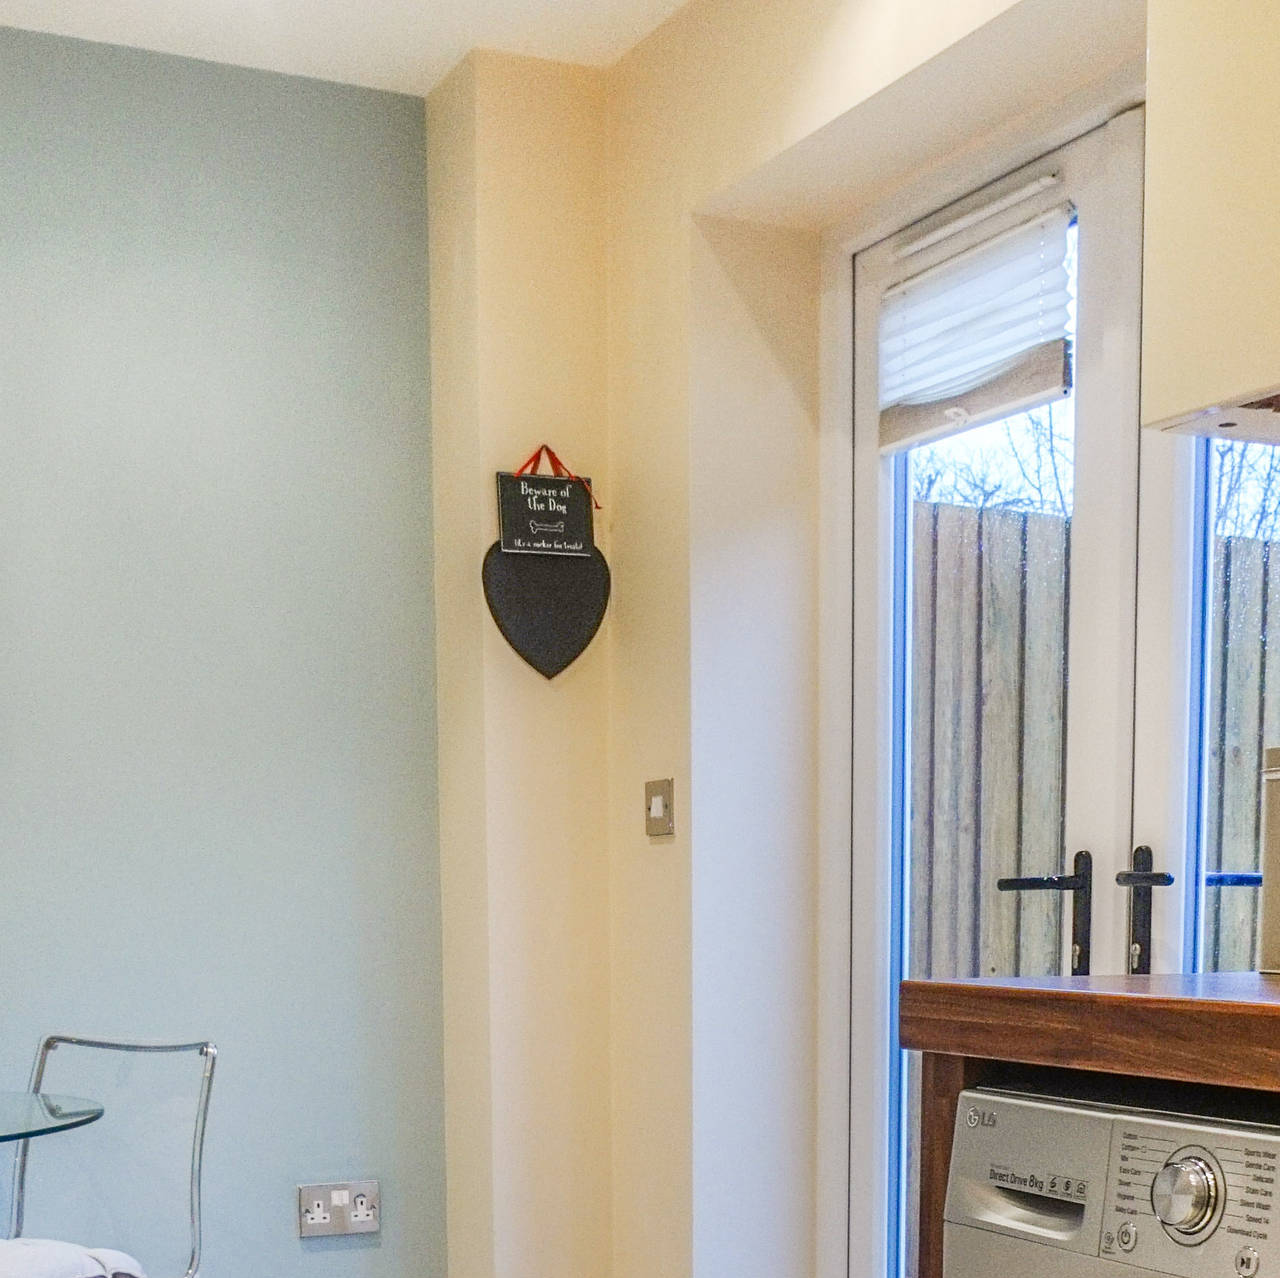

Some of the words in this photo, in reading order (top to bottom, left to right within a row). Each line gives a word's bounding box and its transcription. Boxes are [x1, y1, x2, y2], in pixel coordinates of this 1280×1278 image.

[521, 481, 557, 497] Beware
[560, 484, 572, 497] of
[549, 498, 567, 515] Dog
[990, 1169, 1009, 1183] Direct
[1011, 1173, 1027, 1186] Drive
[1029, 1174, 1044, 1191] 8kg
